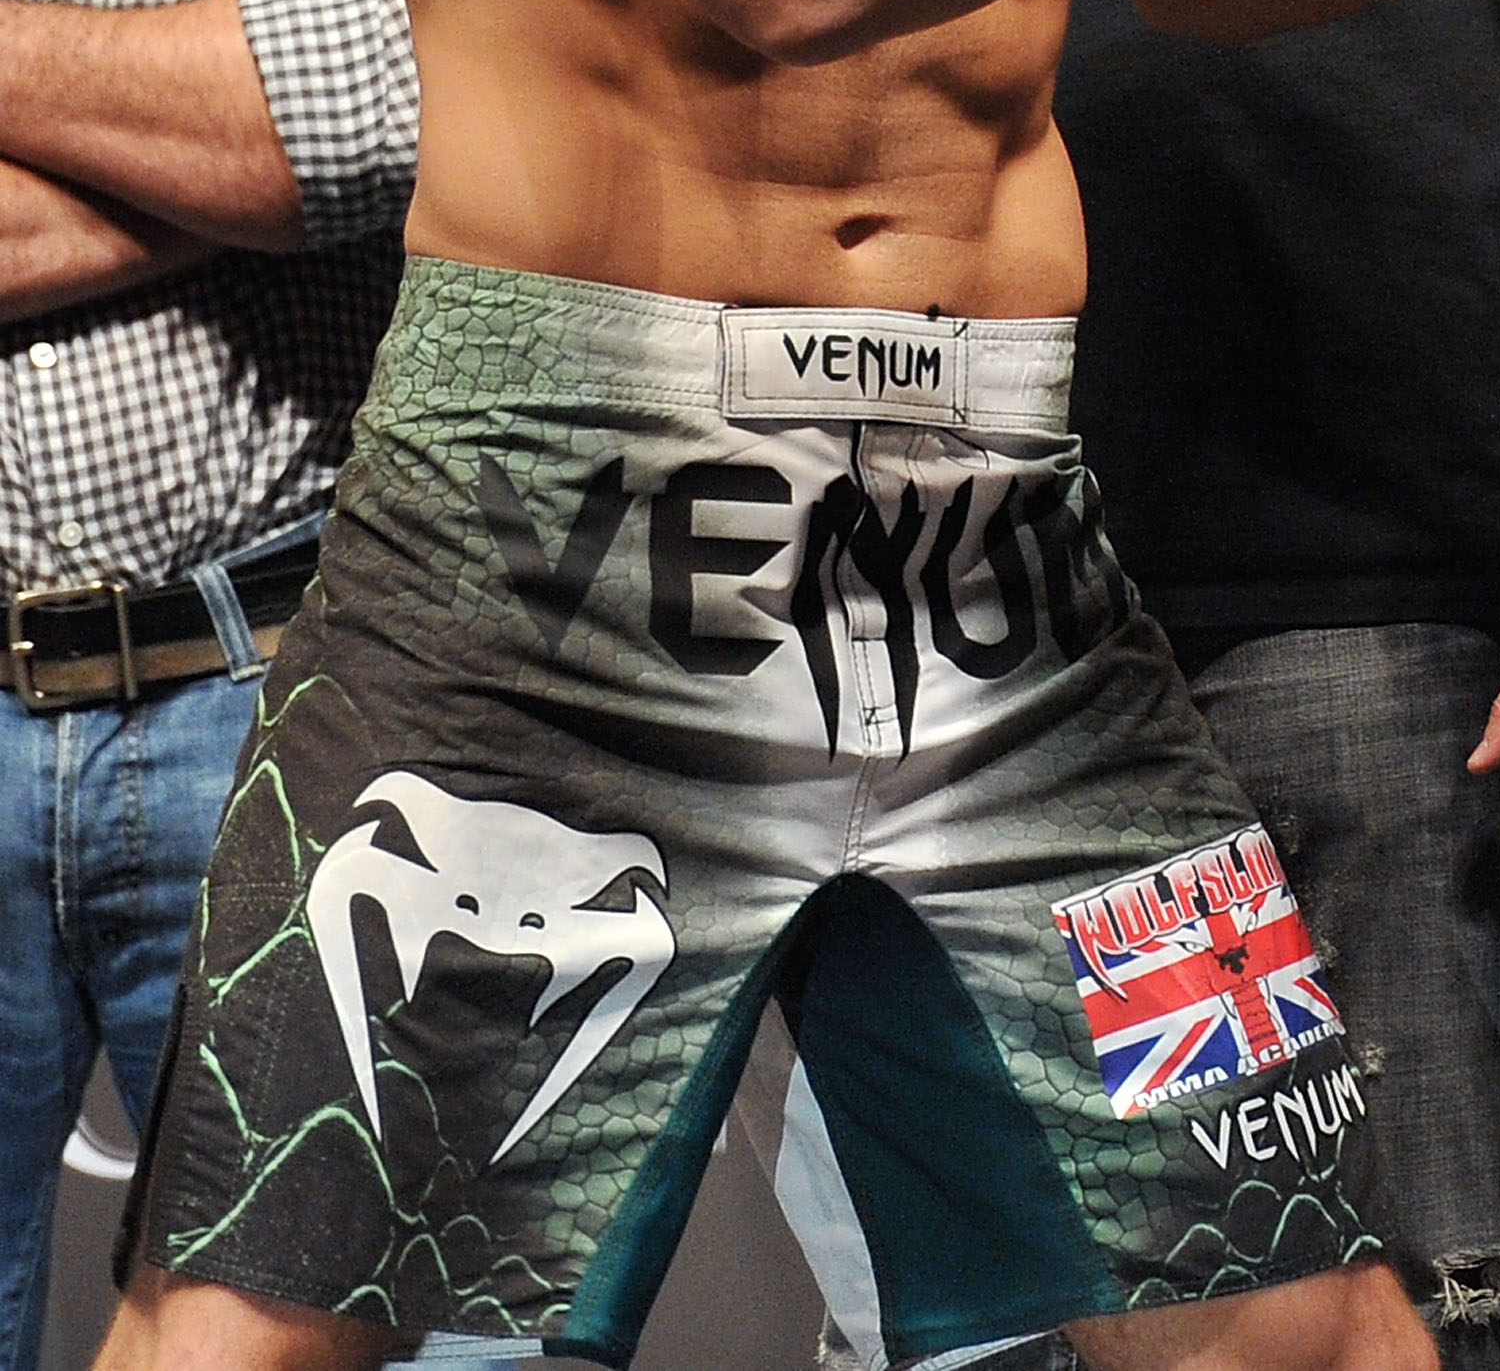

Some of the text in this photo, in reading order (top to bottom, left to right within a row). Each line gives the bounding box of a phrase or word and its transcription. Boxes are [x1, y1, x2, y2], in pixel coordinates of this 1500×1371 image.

[781, 332, 941, 397] VENUM
[1133, 1066, 1229, 1110] MMA
[1190, 1063, 1366, 1171] VENUM
